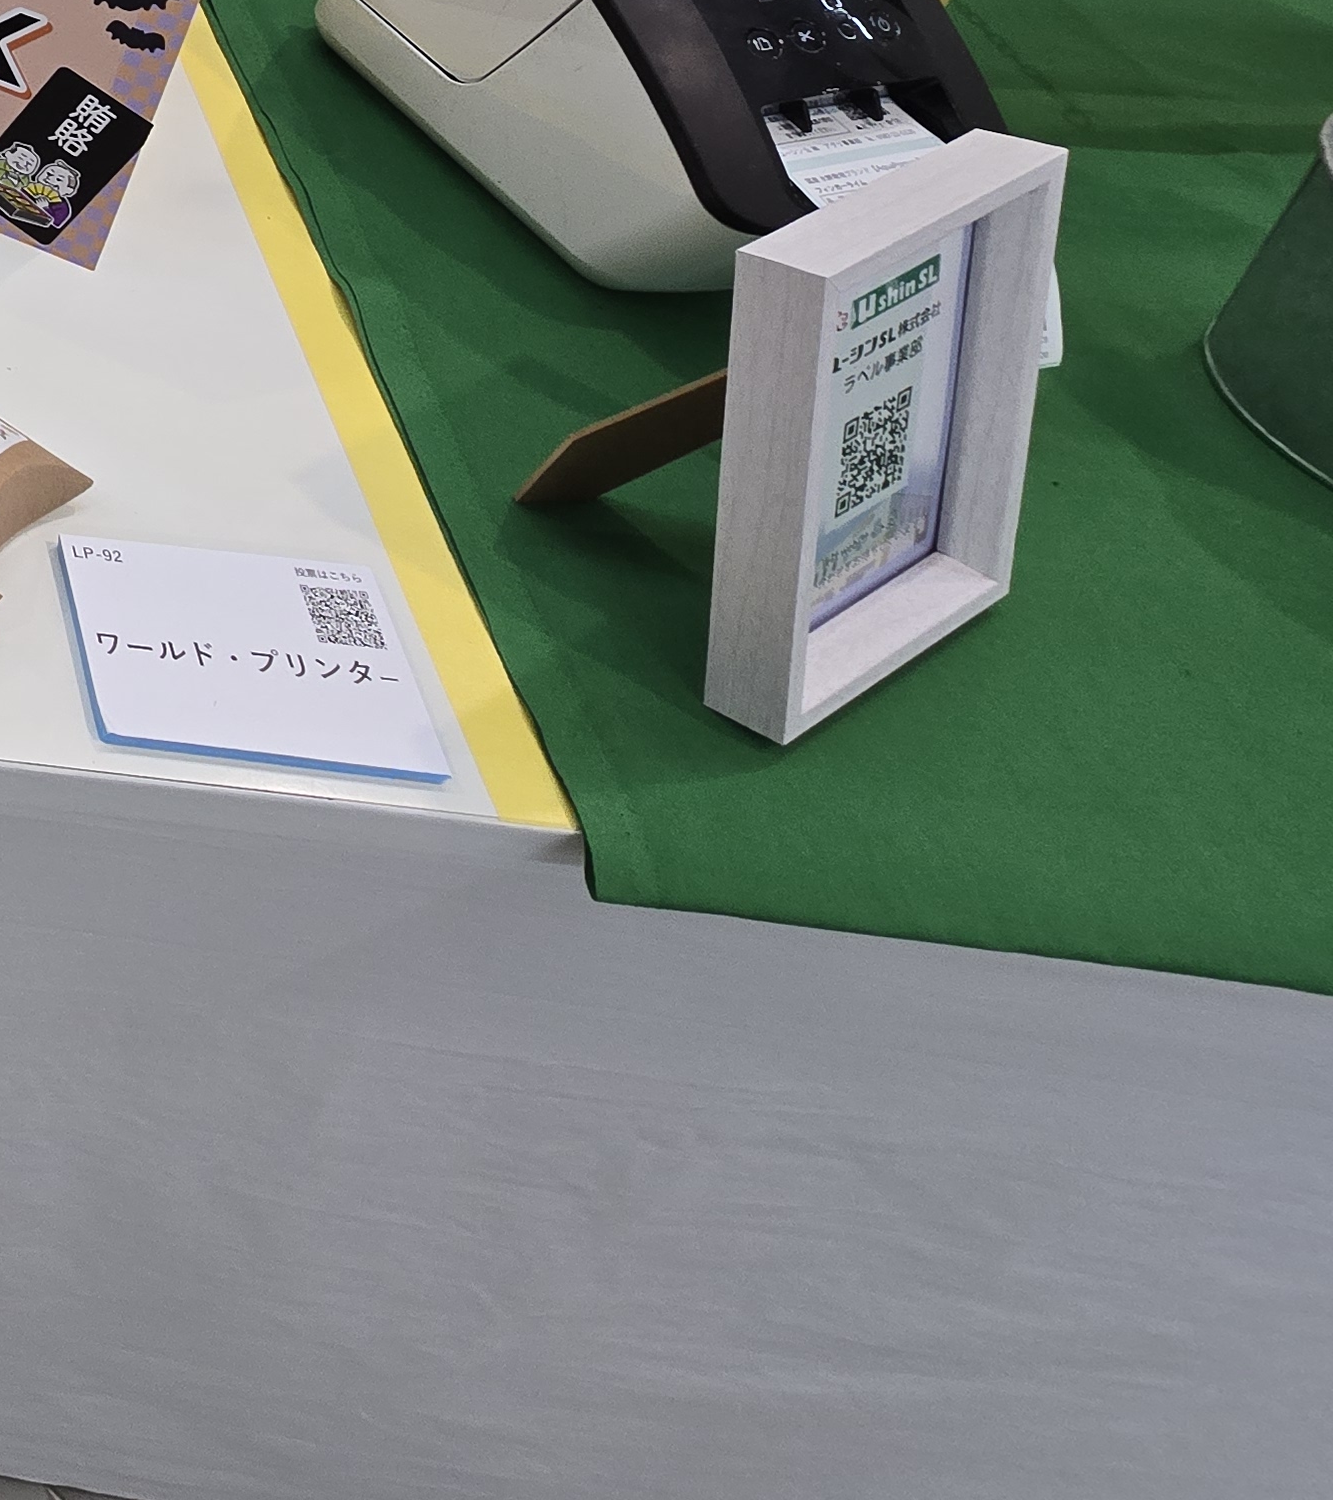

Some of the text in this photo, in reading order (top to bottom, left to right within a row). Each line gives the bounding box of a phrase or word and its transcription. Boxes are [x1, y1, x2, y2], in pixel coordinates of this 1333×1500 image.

[48, 93, 117, 158] 賄賂
[71, 545, 124, 563] LP-92
[294, 567, 363, 584] 投票はこちら
[96, 632, 399, 685] ワールド・プリンター
